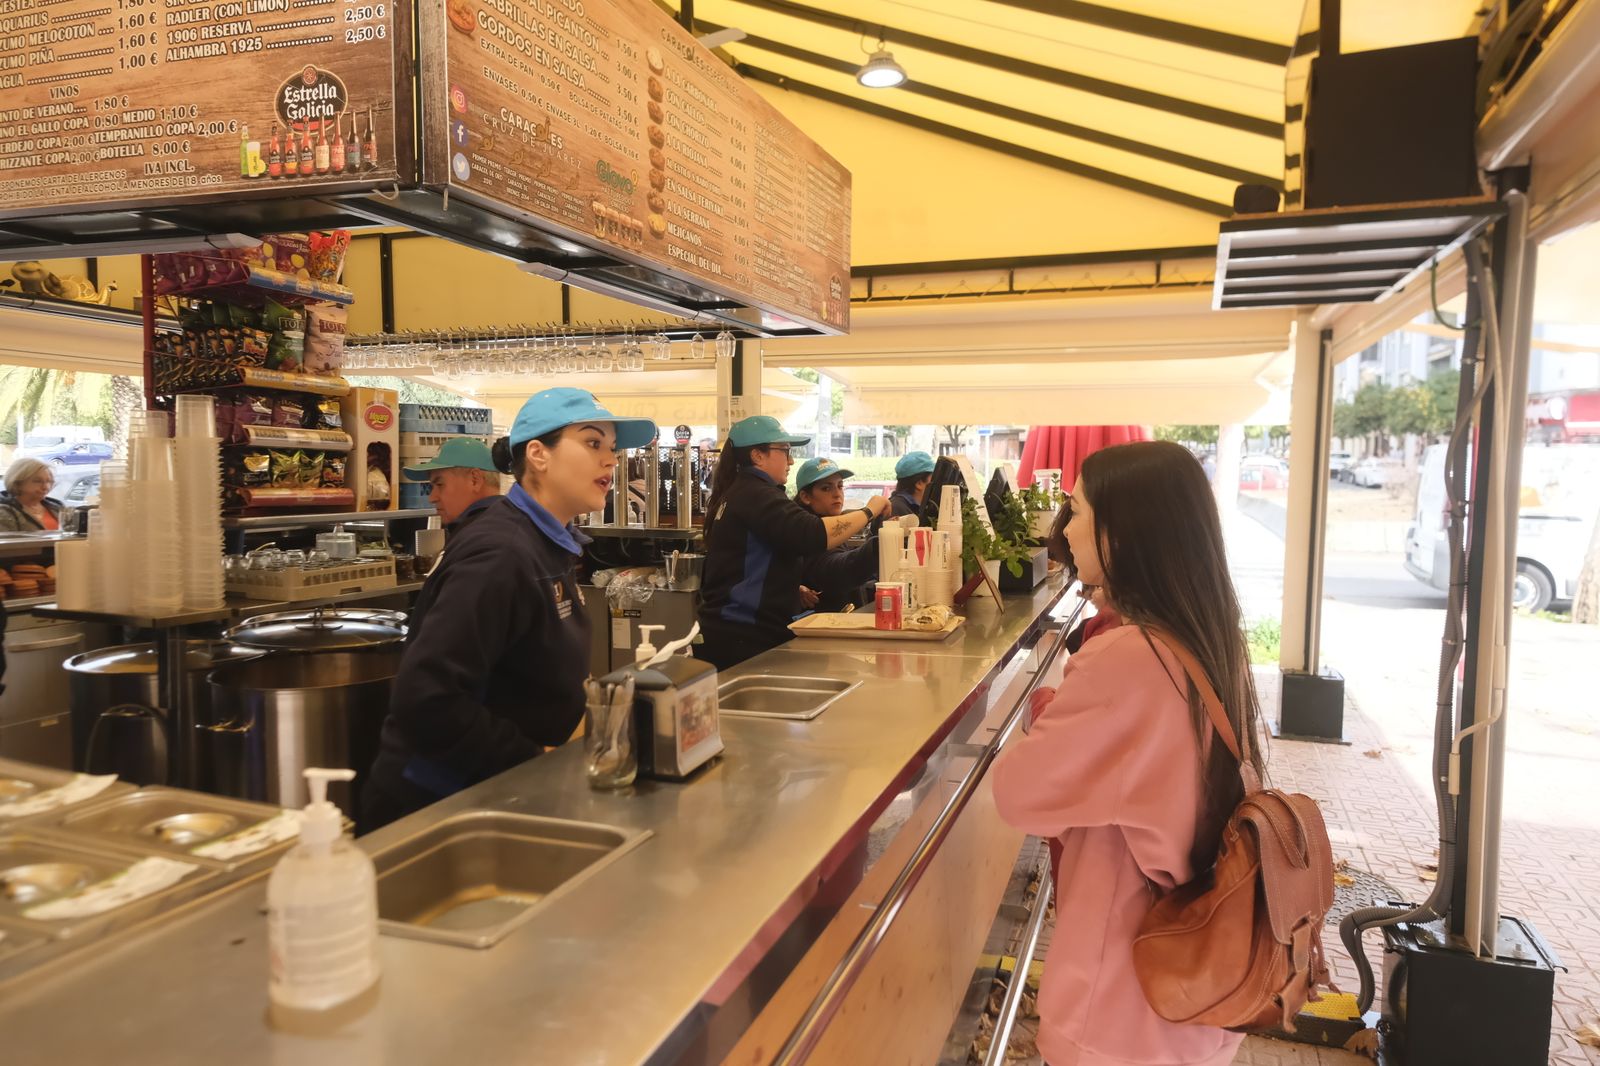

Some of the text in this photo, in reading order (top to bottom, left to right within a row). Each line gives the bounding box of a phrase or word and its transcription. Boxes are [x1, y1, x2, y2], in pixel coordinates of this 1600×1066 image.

[166, 8, 211, 26] RADLER
[213, 2, 243, 22] (CON
[167, 4, 385, 45] 1906 RESERVA 2,50 €
[546, 3, 600, 54] PICANTON
[28, 22, 95, 47] MELOCOTON
[118, 14, 145, 30] 1,60
[149, 12, 158, 24] €
[165, 25, 386, 62] ALHAMBRA 1925 2,50 €
[485, 0, 545, 40] ABRILLAS
[548, 28, 564, 53] EN
[565, 41, 598, 76] SALSA
[29, 47, 55, 66] PIÑA
[118, 34, 146, 50] 1,60
[149, 32, 158, 45] €
[119, 54, 146, 70] 1,00
[150, 52, 158, 65] €
[480, 38, 506, 61] EXTRA
[508, 55, 519, 68] DE
[519, 61, 534, 77] PAN
[569, 91, 588, 109] BOLSA
[590, 104, 598, 115] DE
[534, 44, 551, 69] EN
[552, 56, 587, 93] SALSA
[49, 84, 80, 100] VINOS
[284, 83, 337, 104] Estrella
[483, 67, 518, 94] ENVASES
[546, 101, 571, 123] ENVASE
[17, 124, 29, 137] EL
[31, 119, 60, 135] GALLO
[63, 116, 89, 131] COPA
[122, 108, 156, 124] MEDIO
[160, 106, 186, 121] 1,10
[189, 104, 198, 118] €
[22, 107, 35, 120] DE
[94, 96, 118, 111] 1,80
[121, 95, 128, 107] €
[286, 101, 334, 120] Galicia
[36, 136, 62, 150] COPA
[63, 135, 85, 149] 2,00
[88, 134, 94, 145] €
[94, 124, 163, 144] TEMPRANILLO
[166, 121, 195, 137] COPA
[198, 121, 225, 138] 2,00
[229, 120, 237, 133] €
[483, 113, 515, 137] CRUZ
[522, 133, 536, 148] DE
[45, 151, 71, 164] COPA
[71, 153, 91, 166] 2,00
[94, 151, 100, 162] €
[100, 143, 145, 160] BOTELLA
[151, 141, 178, 157] 8,00
[182, 140, 190, 153] €
[144, 160, 195, 175] IVA INCL.
[68, 174, 78, 183] DE
[84, 182, 121, 193] ALCOHOL
[123, 182, 128, 190] A
[130, 178, 170, 189] MENORES
[173, 177, 185, 186] DE
[187, 176, 196, 185] 18
[201, 174, 222, 185] años
[668, 243, 698, 266] ESPECIAL
